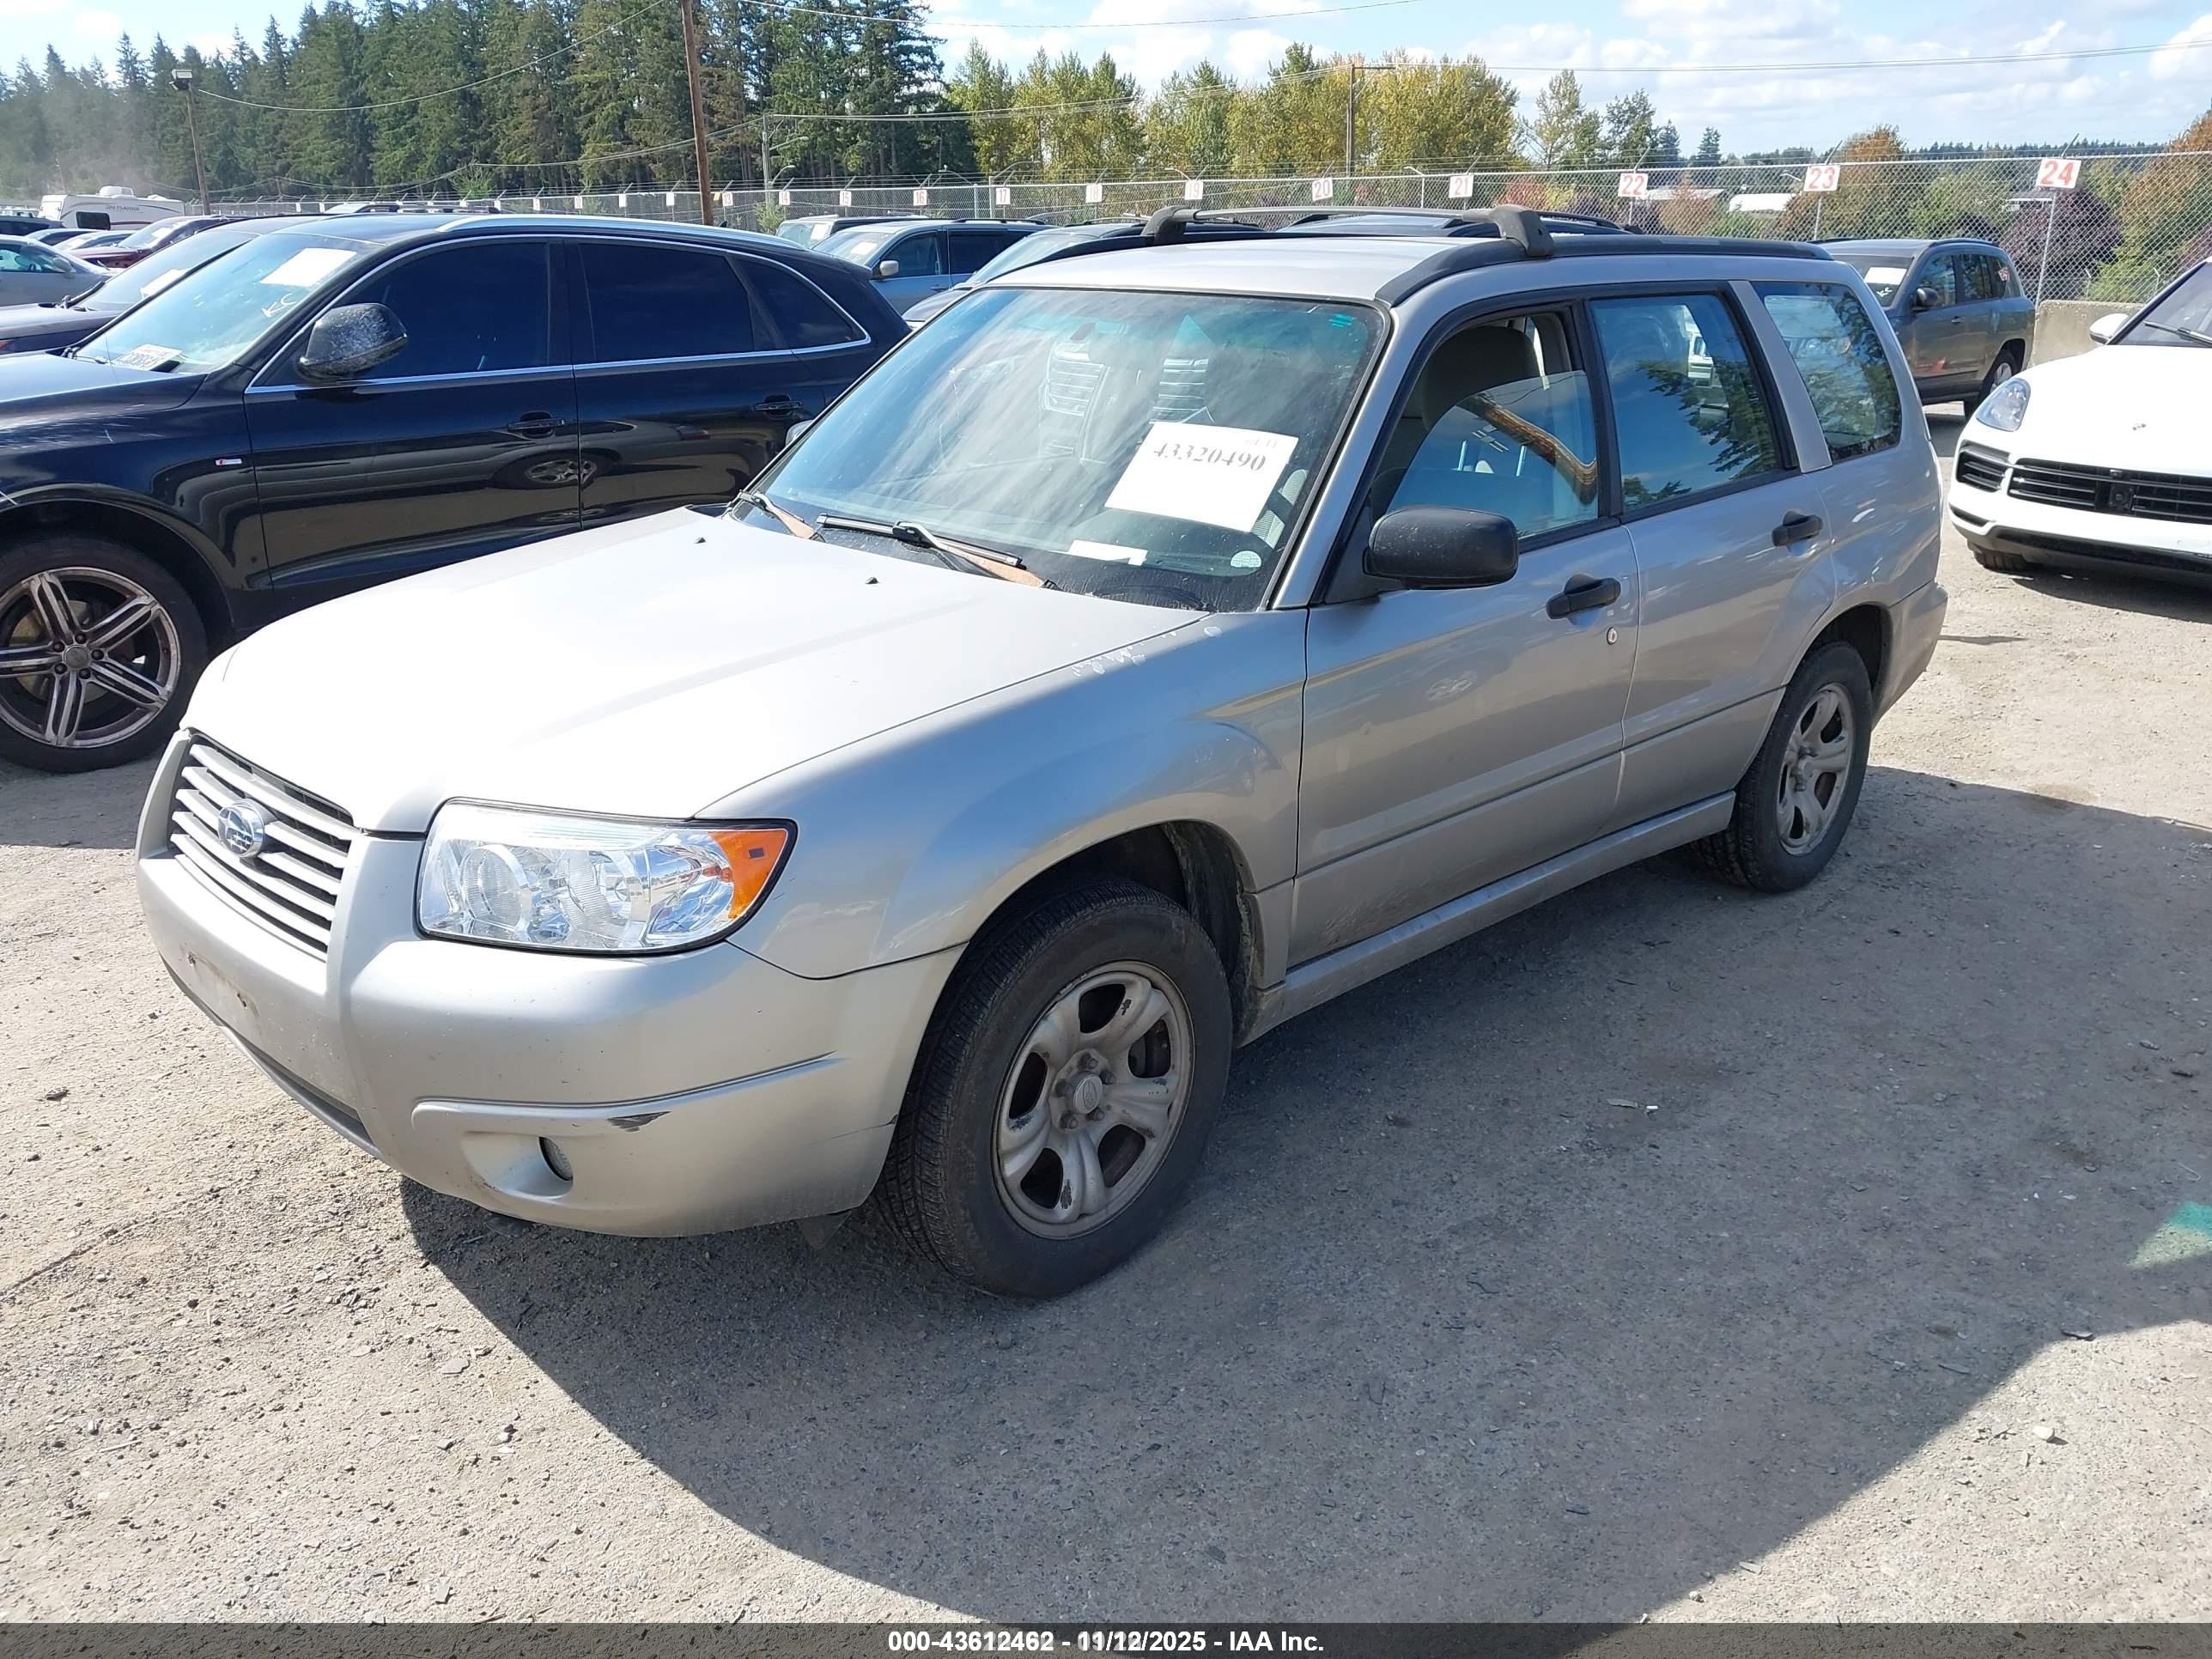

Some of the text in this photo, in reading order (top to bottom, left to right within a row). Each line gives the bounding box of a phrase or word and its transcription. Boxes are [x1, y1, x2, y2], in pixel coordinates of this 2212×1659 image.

[1808, 166, 1834, 190] 23
[2040, 161, 2073, 185] 24
[1090, 185, 1099, 202] 18
[1188, 182, 1200, 198] 19
[1314, 180, 1331, 198] 20
[1455, 178, 1469, 196] 21
[1621, 174, 1645, 196] 22
[724, 192, 732, 205] 13
[780, 191, 788, 204] 14
[842, 191, 849, 204] 15
[915, 191, 926, 204] 16
[999, 189, 1008, 203] 17
[1153, 442, 1266, 471] 43320490
